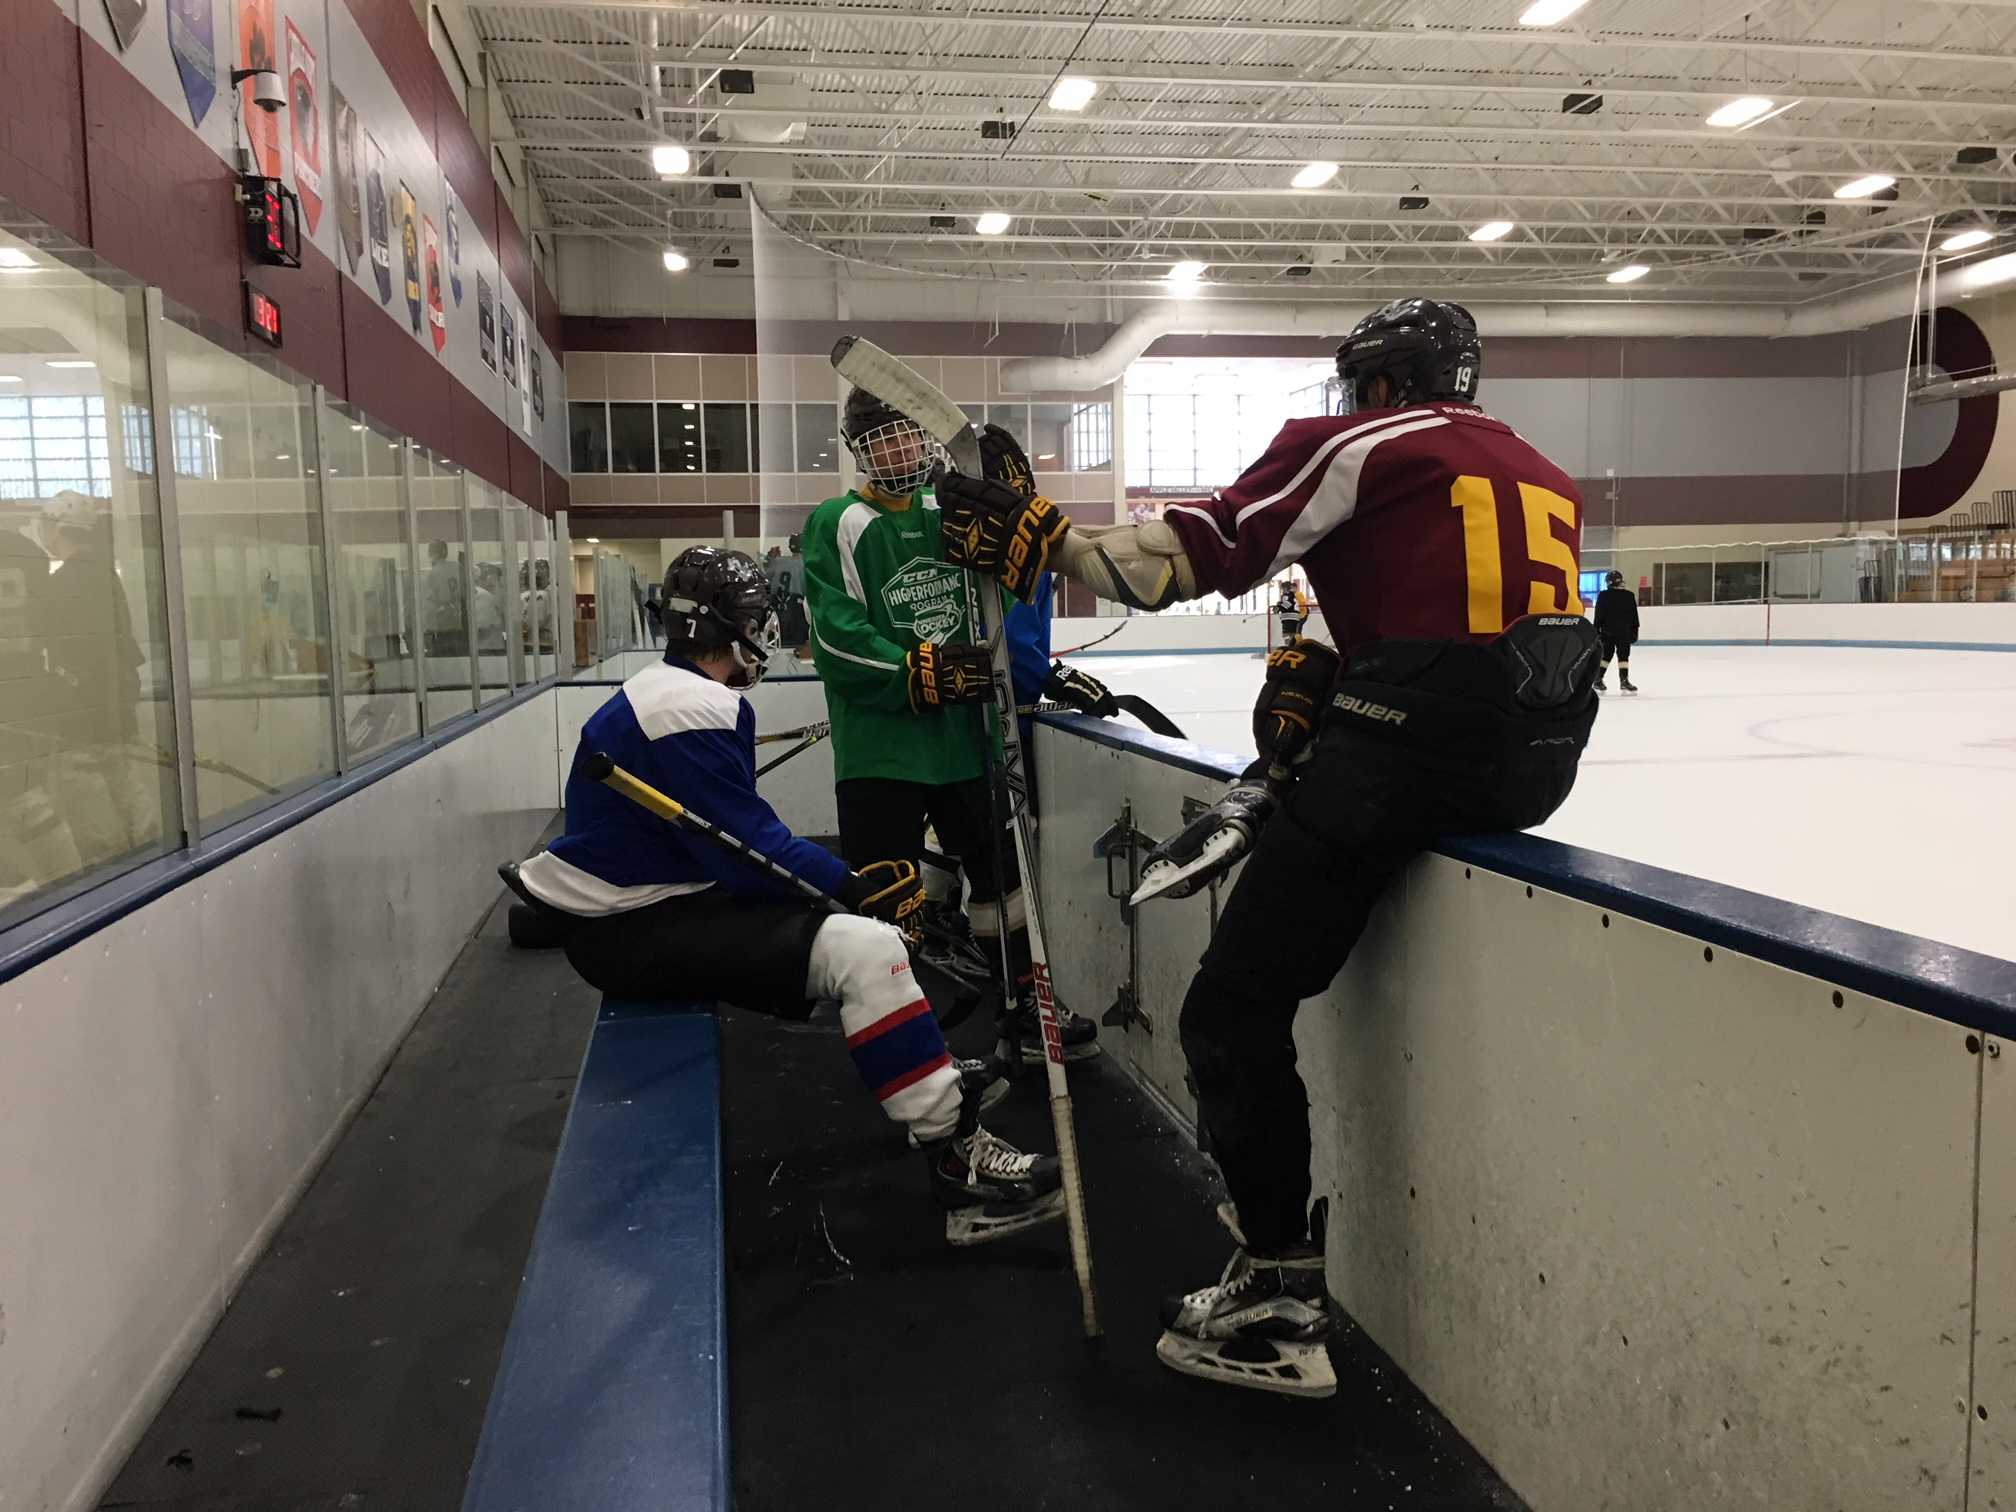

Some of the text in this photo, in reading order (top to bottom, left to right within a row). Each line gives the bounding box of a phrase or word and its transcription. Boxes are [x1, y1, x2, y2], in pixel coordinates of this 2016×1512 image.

[1454, 366, 1472, 392] 19
[1450, 474, 1584, 633] 15
[686, 618, 697, 638] 7
[1537, 617, 1580, 626] BAUER
[1332, 692, 1408, 725] BAUER
[1033, 962, 1065, 1065] BAUER
